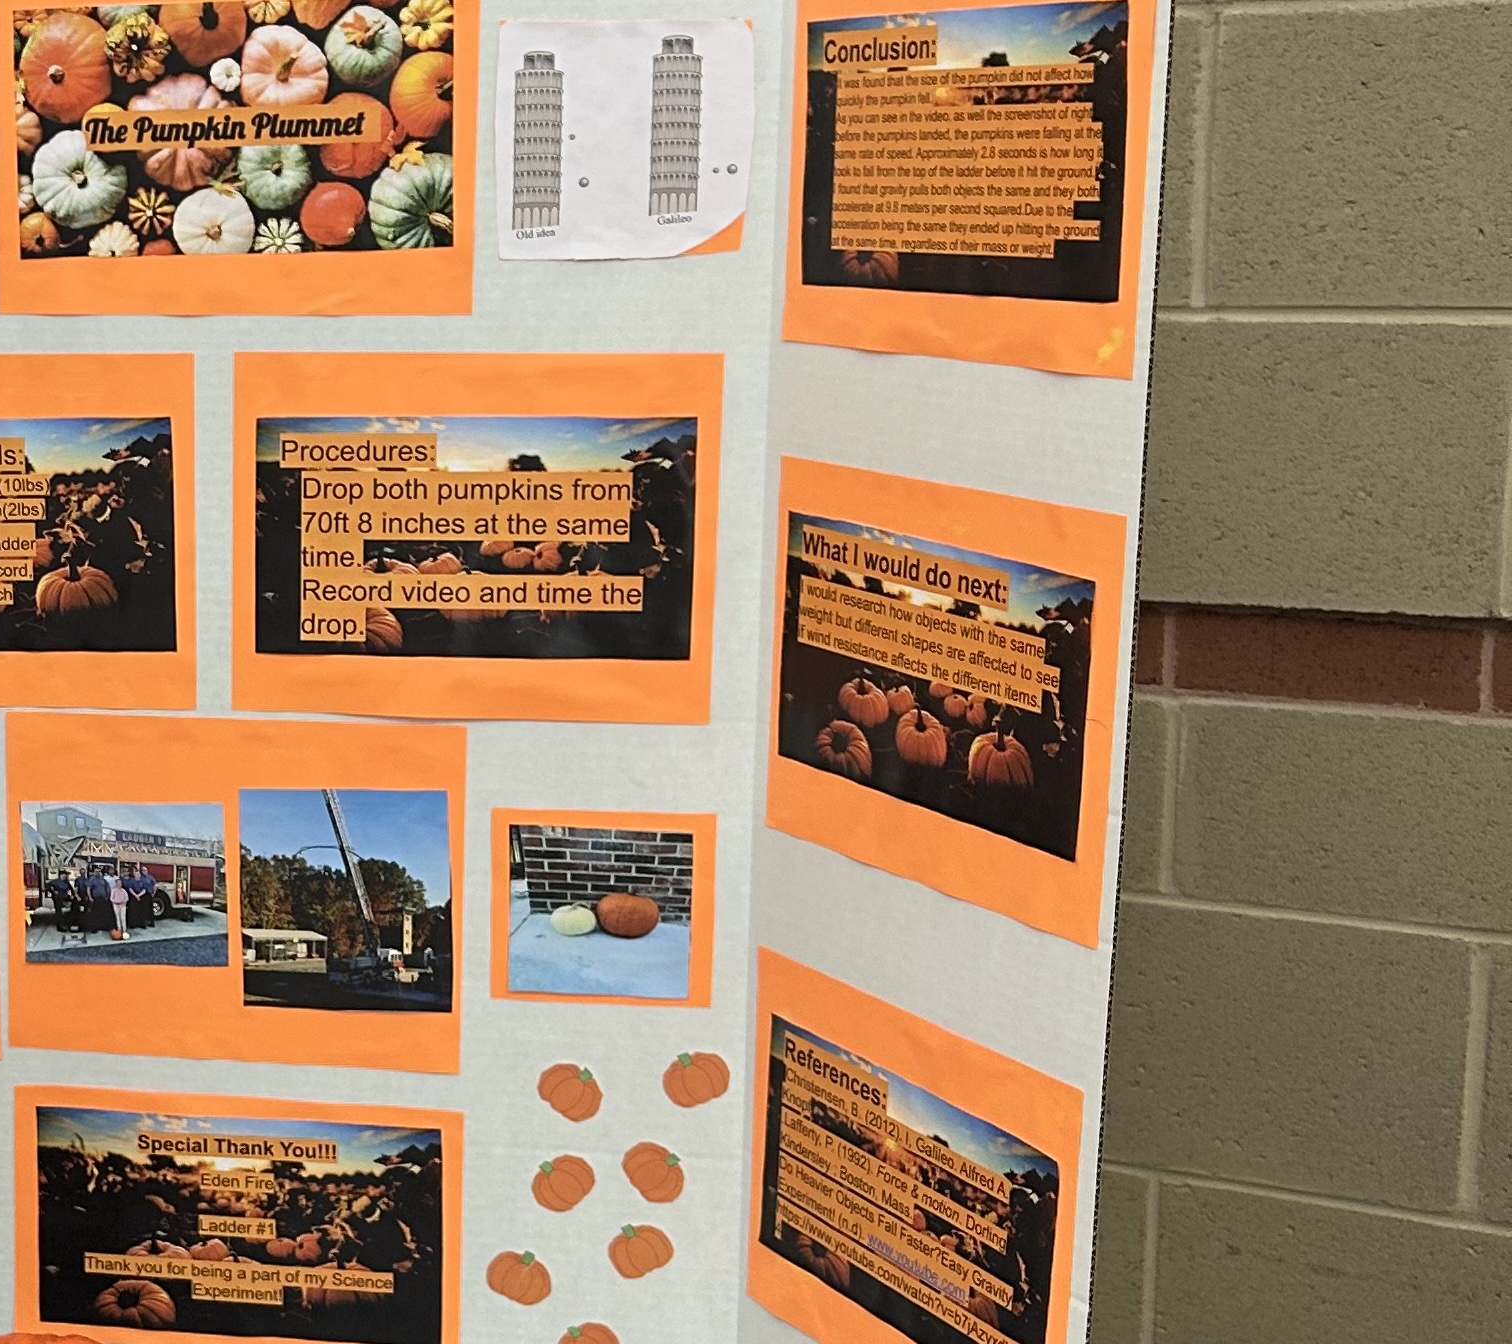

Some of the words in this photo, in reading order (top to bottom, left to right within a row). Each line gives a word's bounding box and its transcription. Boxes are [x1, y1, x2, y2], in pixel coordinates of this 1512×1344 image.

[825, 35, 936, 63] Conclusion:
[86, 118, 127, 144] The
[133, 115, 246, 146] Pumpkin
[251, 112, 365, 138] Plummet
[516, 230, 534, 240] Old
[536, 229, 555, 238] idea
[281, 440, 436, 462] Procedures:
[303, 478, 363, 504] Drop
[373, 478, 428, 499] both
[438, 478, 562, 504] pumpkins
[572, 478, 631, 500] from
[303, 512, 349, 533] 70ft
[358, 513, 372, 533] 8
[382, 512, 465, 534] inches
[474, 515, 498, 534] at
[508, 513, 546, 534] the
[557, 518, 628, 534] same
[302, 547, 362, 567] time.
[804, 532, 848, 563] What
[854, 544, 858, 565] I
[864, 551, 920, 581] would
[926, 563, 951, 589] do
[958, 574, 1007, 604] next:
[303, 580, 392, 601] Record
[401, 580, 470, 603] video
[480, 581, 527, 603] and
[537, 581, 591, 604] time
[601, 581, 642, 604] the
[301, 613, 365, 638] drop.
[807, 585, 836, 602] would
[840, 593, 886, 615] research
[890, 604, 913, 622] how
[916, 611, 956, 634] objects
[960, 624, 984, 642] with
[989, 630, 1006, 648] the
[1010, 638, 1044, 658] same
[836, 612, 852, 629] but
[855, 618, 898, 642] different
[901, 633, 943, 655] shapes
[947, 645, 965, 662] are
[969, 650, 1016, 676] affected
[1021, 664, 1032, 680] to
[1036, 671, 1058, 688] see
[807, 629, 830, 645] wind
[834, 636, 888, 662] resistance
[891, 652, 927, 674] affects
[932, 663, 948, 681] the
[952, 670, 1000, 697] different
[1005, 682, 1040, 708] items.
[785, 1037, 886, 1110] References:
[138, 1135, 207, 1155] Special
[215, 1138, 274, 1157] Thank
[281, 1142, 336, 1160] You!!!
[865, 1110, 902, 1142] (2012).
[960, 1162, 994, 1190] Alfred
[201, 1173, 239, 1188] Eden
[245, 1176, 273, 1190] Fire
[877, 1165, 908, 1192] Force
[911, 1184, 919, 1199] &
[966, 1216, 1006, 1252] Dorling
[200, 1219, 251, 1234] Ladder
[256, 1222, 274, 1235] #1
[88, 1256, 130, 1272] Thank
[136, 1263, 162, 1277] you
[168, 1261, 187, 1275] for
[192, 1263, 232, 1281] being
[238, 1270, 245, 1279] a
[251, 1268, 280, 1285] part
[286, 1269, 300, 1282] of
[304, 1275, 326, 1288] my
[333, 1273, 393, 1289] Science
[193, 1283, 281, 1302] Experiment!
